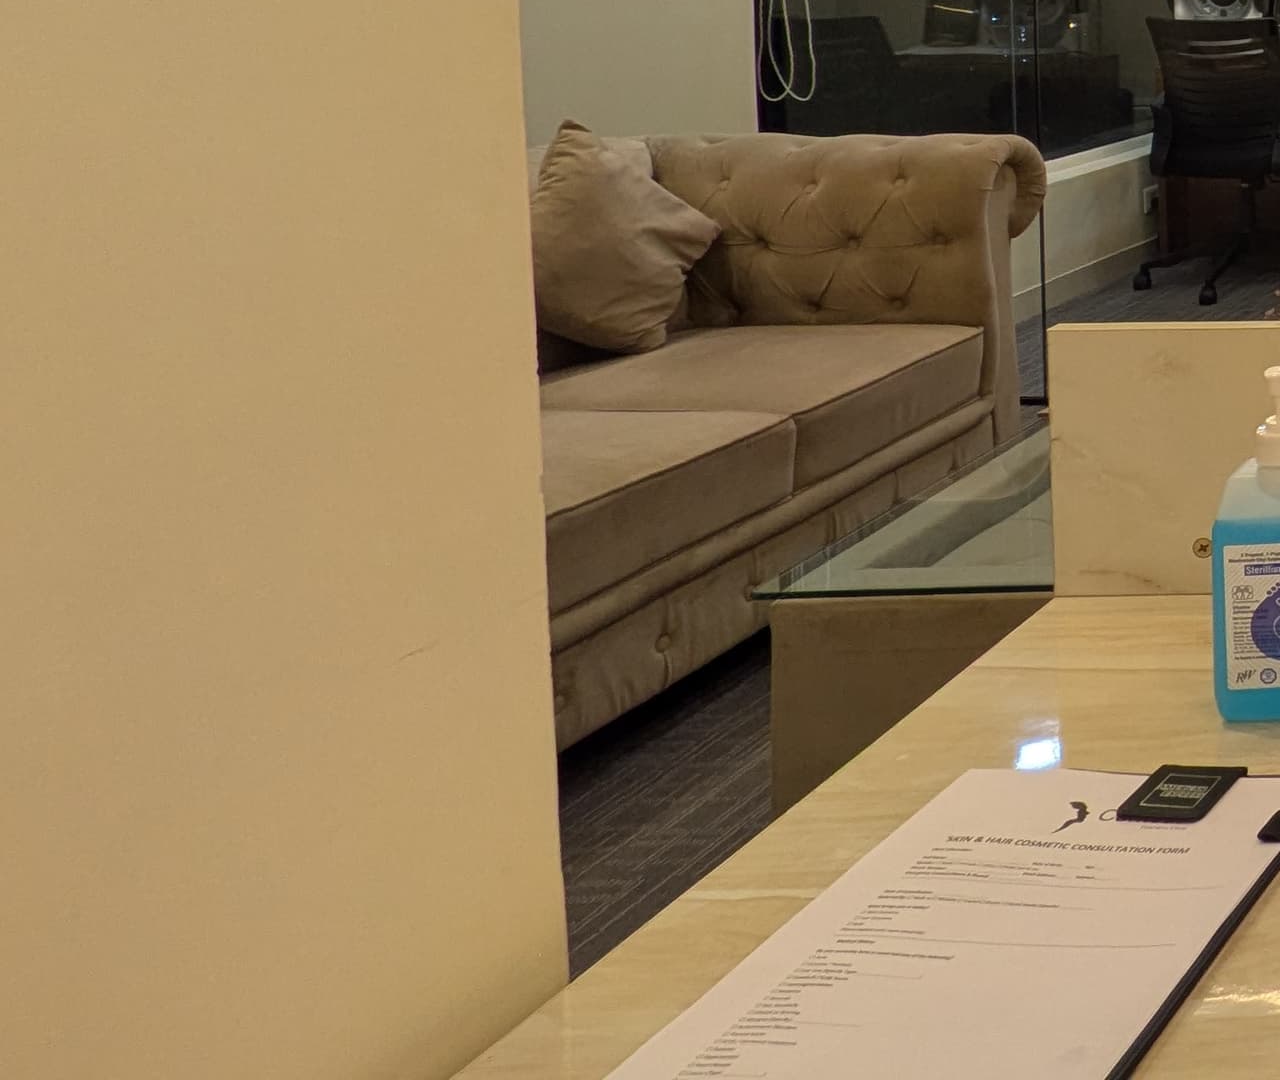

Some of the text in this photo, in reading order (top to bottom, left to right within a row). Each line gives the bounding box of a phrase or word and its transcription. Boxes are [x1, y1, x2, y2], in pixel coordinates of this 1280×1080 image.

[946, 835, 973, 844] SKIN
[985, 837, 1014, 846] HAIR
[1014, 839, 1071, 851] COSMETIC
[1070, 842, 1156, 855] CONSULTATION
[1156, 846, 1192, 856] FORM
